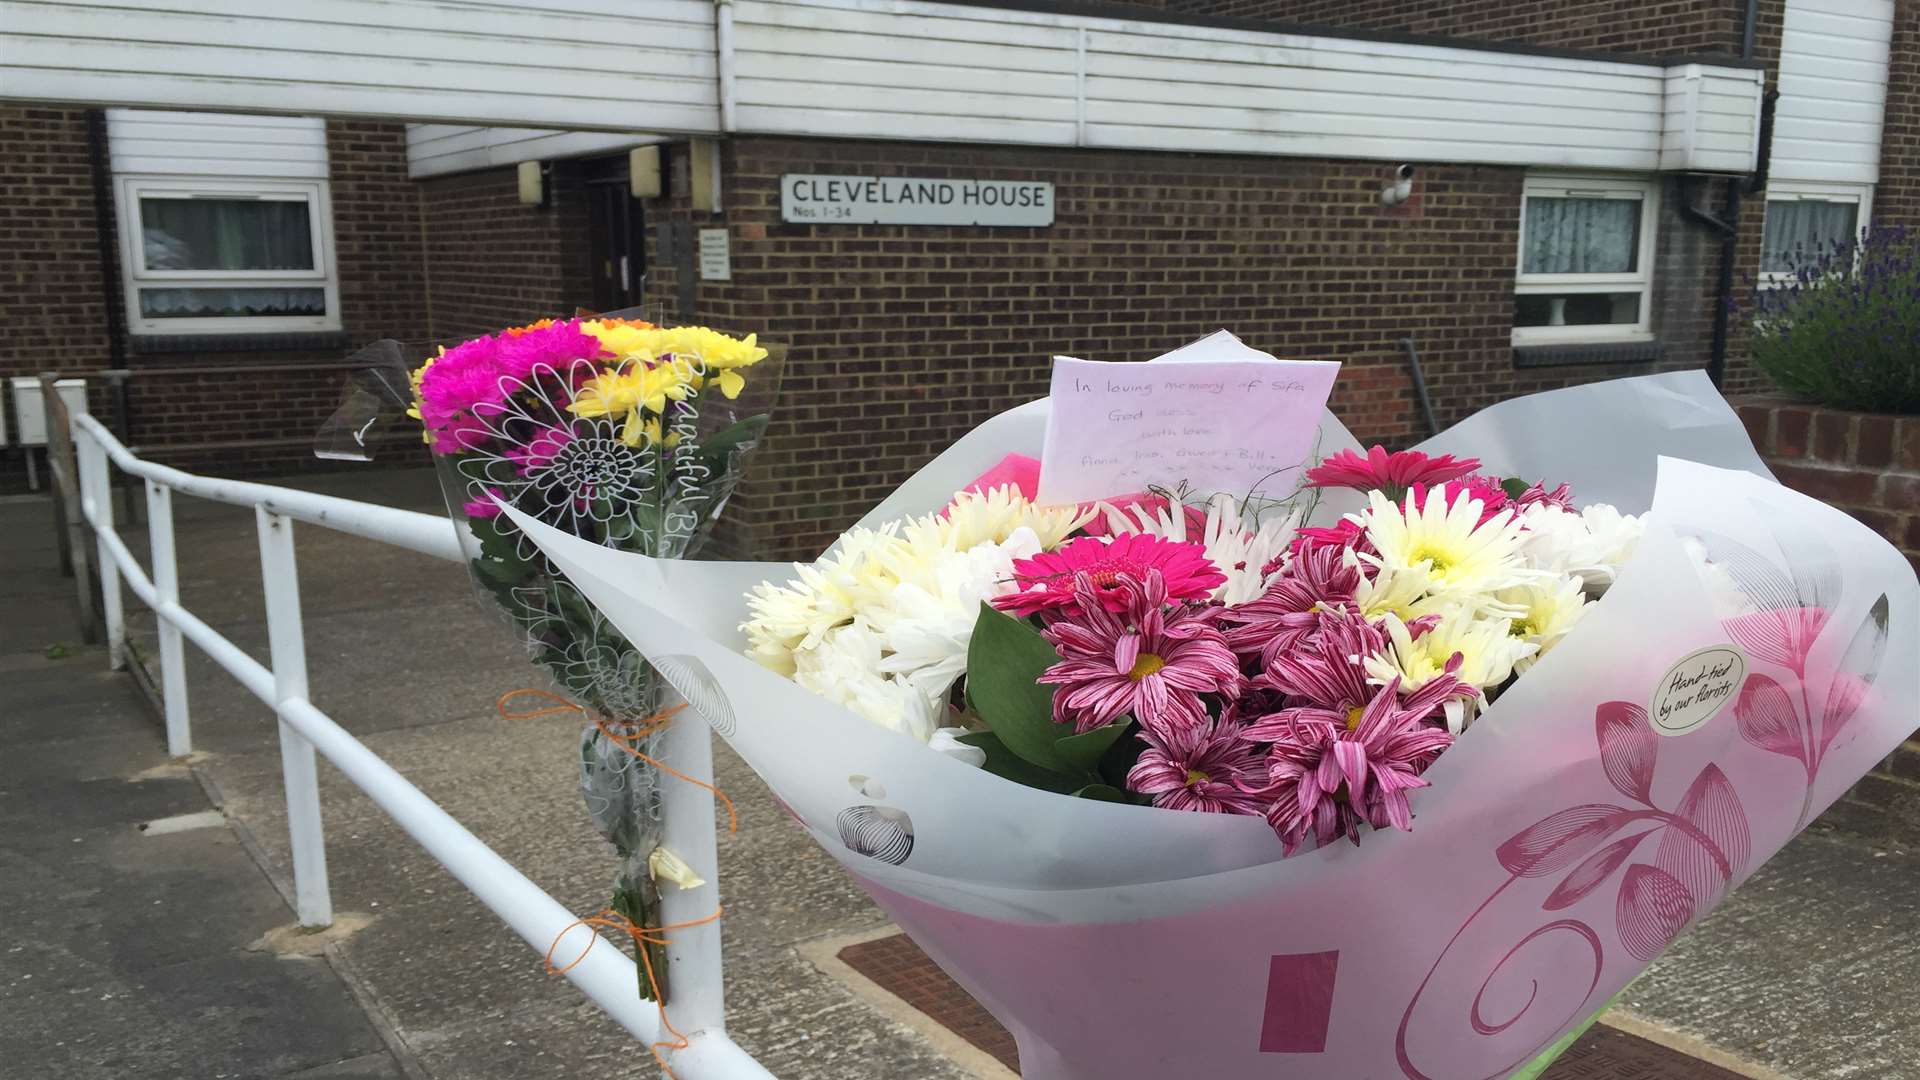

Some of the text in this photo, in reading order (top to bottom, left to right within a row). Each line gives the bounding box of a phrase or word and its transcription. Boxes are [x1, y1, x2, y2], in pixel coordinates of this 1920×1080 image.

[793, 180, 1045, 207] CLEVELAND HOUSE
[823, 207, 851, 217] 1-34
[1075, 378, 1091, 393] In
[1107, 380, 1153, 397] loving
[1164, 382, 1226, 395] memory
[672, 352, 709, 505] Beautiful
[1668, 658, 1733, 694] Hand-tied
[1660, 681, 1732, 721] by our florists
